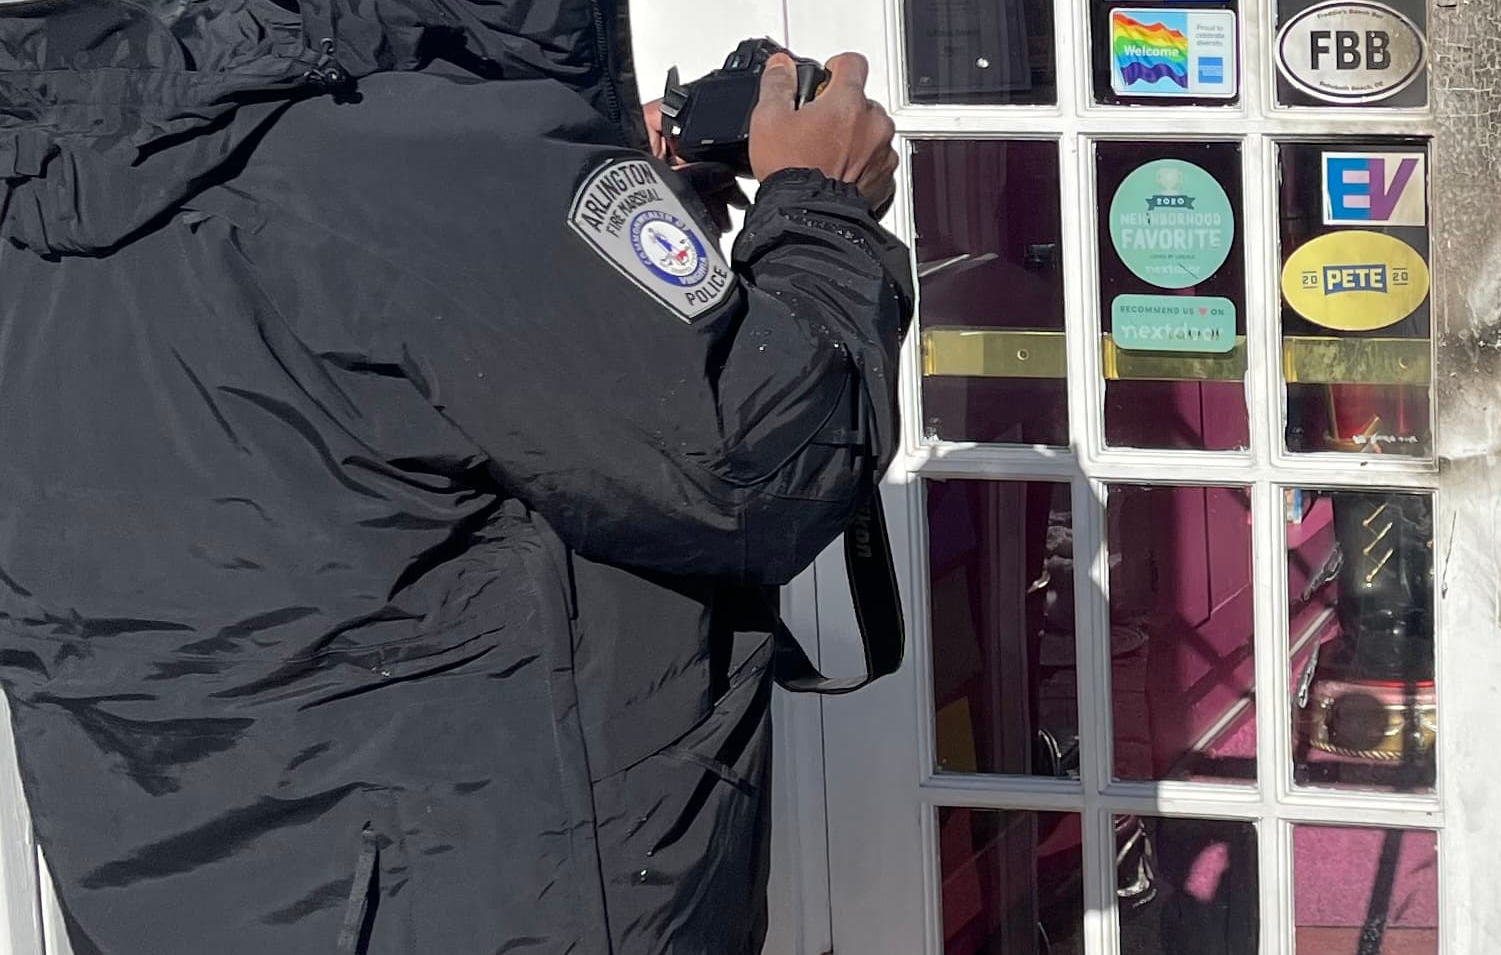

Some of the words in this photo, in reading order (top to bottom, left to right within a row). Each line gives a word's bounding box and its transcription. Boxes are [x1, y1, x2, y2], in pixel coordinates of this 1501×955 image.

[1123, 44, 1180, 57] Welcome
[1310, 30, 1391, 70] FBB
[581, 163, 657, 231] ARLINGTON
[1326, 158, 1420, 221] EV
[1156, 197, 1185, 205] 2020
[606, 207, 627, 237] FIRE
[620, 188, 664, 216] MARSHAL
[1120, 212, 1222, 225] NEIGHBORHOOD
[1121, 229, 1222, 250] FAVORITE
[684, 265, 728, 306] POLICE
[1302, 275, 1318, 285] 20
[1326, 267, 1383, 290] PETE
[1392, 271, 1408, 282] 20
[1120, 305, 1180, 315] RECOMMEND
[1183, 307, 1194, 315] US
[1120, 321, 1224, 341] nextdoor
